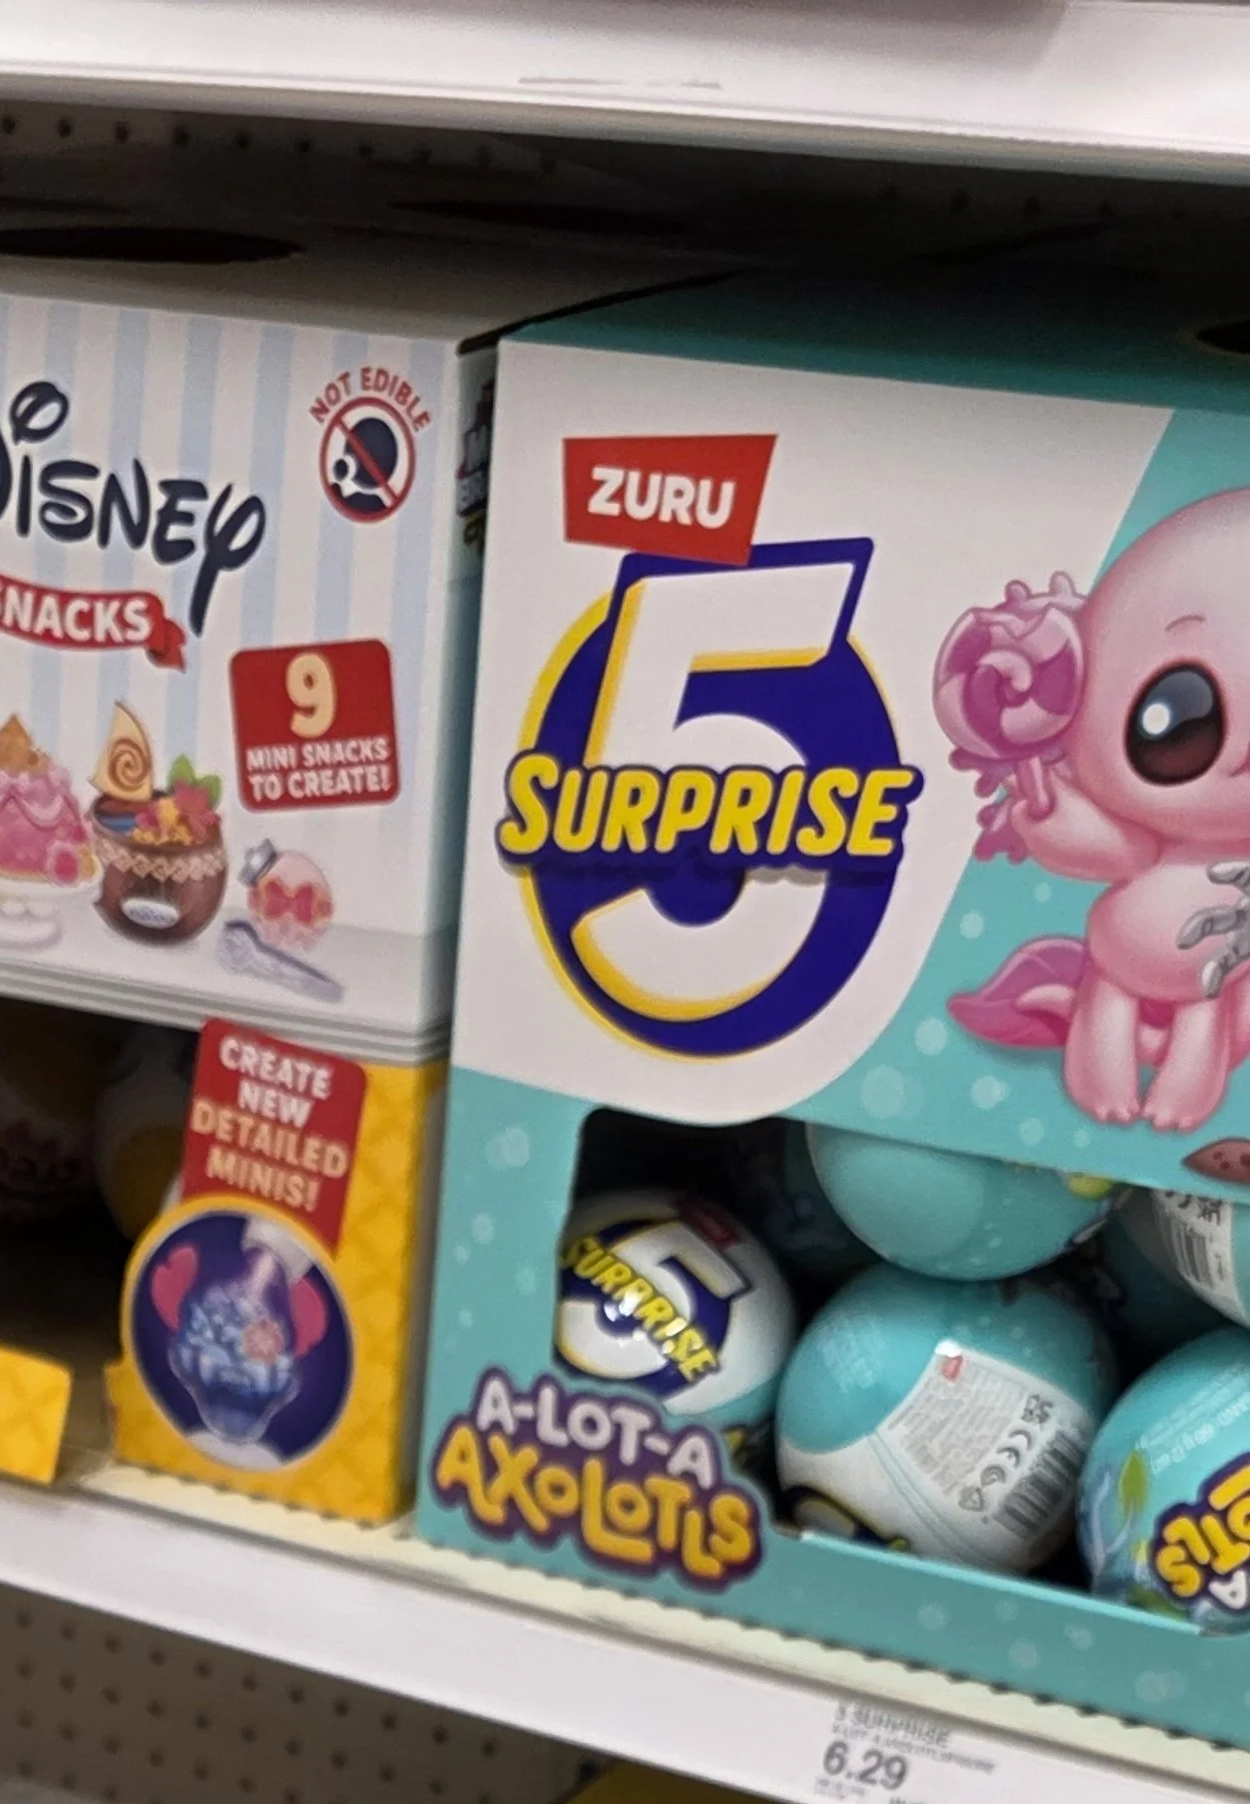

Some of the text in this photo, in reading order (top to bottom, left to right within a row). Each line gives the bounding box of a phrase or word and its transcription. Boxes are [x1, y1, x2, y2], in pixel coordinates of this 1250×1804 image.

[309, 366, 432, 432] NOT EDIBLE
[587, 466, 736, 529] ZURU
[285, 652, 336, 738] 9
[246, 736, 390, 772] MINI SNACKS
[248, 764, 391, 802] TO CREATE!
[498, 755, 916, 857] SURPRISE
[570, 562, 856, 1024] 5
[219, 1036, 334, 1101] CREATE
[238, 1077, 315, 1128] NEW
[190, 1098, 351, 1179] DETAILED
[205, 1145, 321, 1213] MINIS!
[477, 1376, 716, 1490] A-LOT-A
[436, 1425, 753, 1579] AXOLOTLS
[823, 1741, 909, 1790] 6.29
